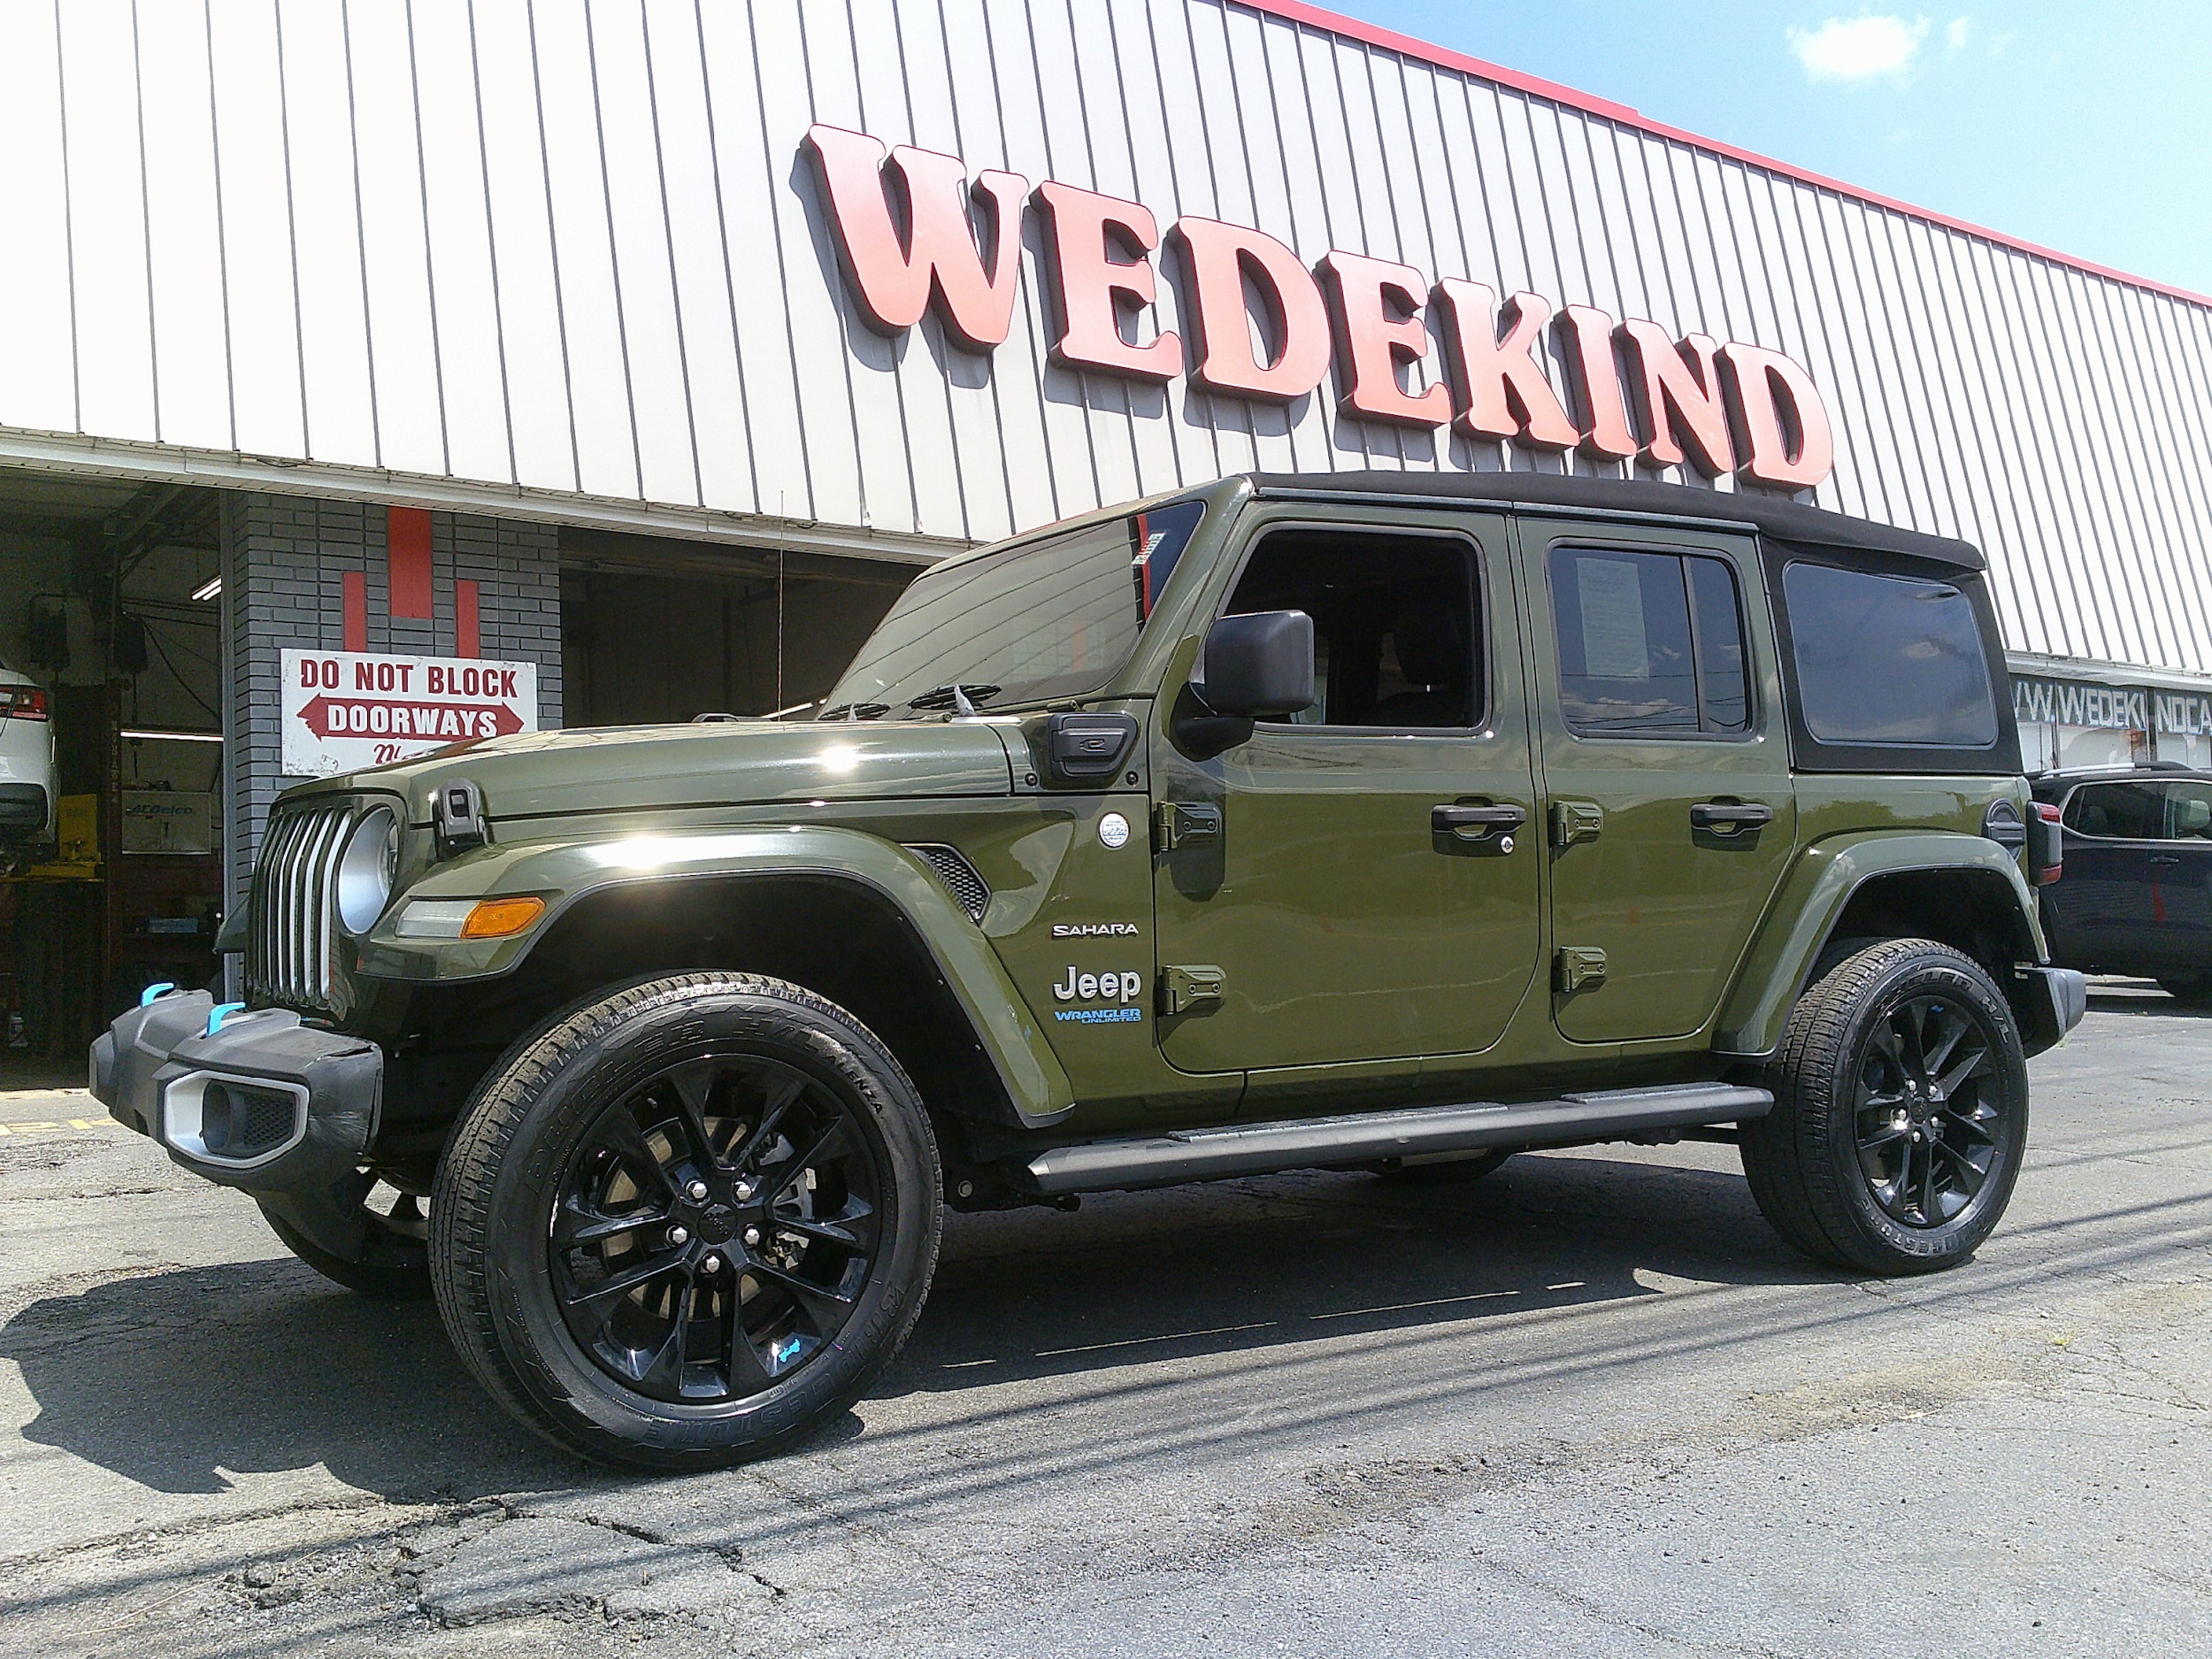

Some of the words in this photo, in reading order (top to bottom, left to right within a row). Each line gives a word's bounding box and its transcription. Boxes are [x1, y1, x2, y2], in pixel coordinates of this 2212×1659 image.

[802, 122, 1833, 489] WEDEKIND
[301, 659, 339, 689] DO
[356, 662, 414, 693] NOT
[428, 666, 518, 698] BLOCK
[327, 704, 497, 738] DOORWAYS
[1052, 923, 1140, 937] SAHARA
[1053, 965, 1142, 1004] Jeep
[1054, 1008, 1142, 1021] WRANGLER
